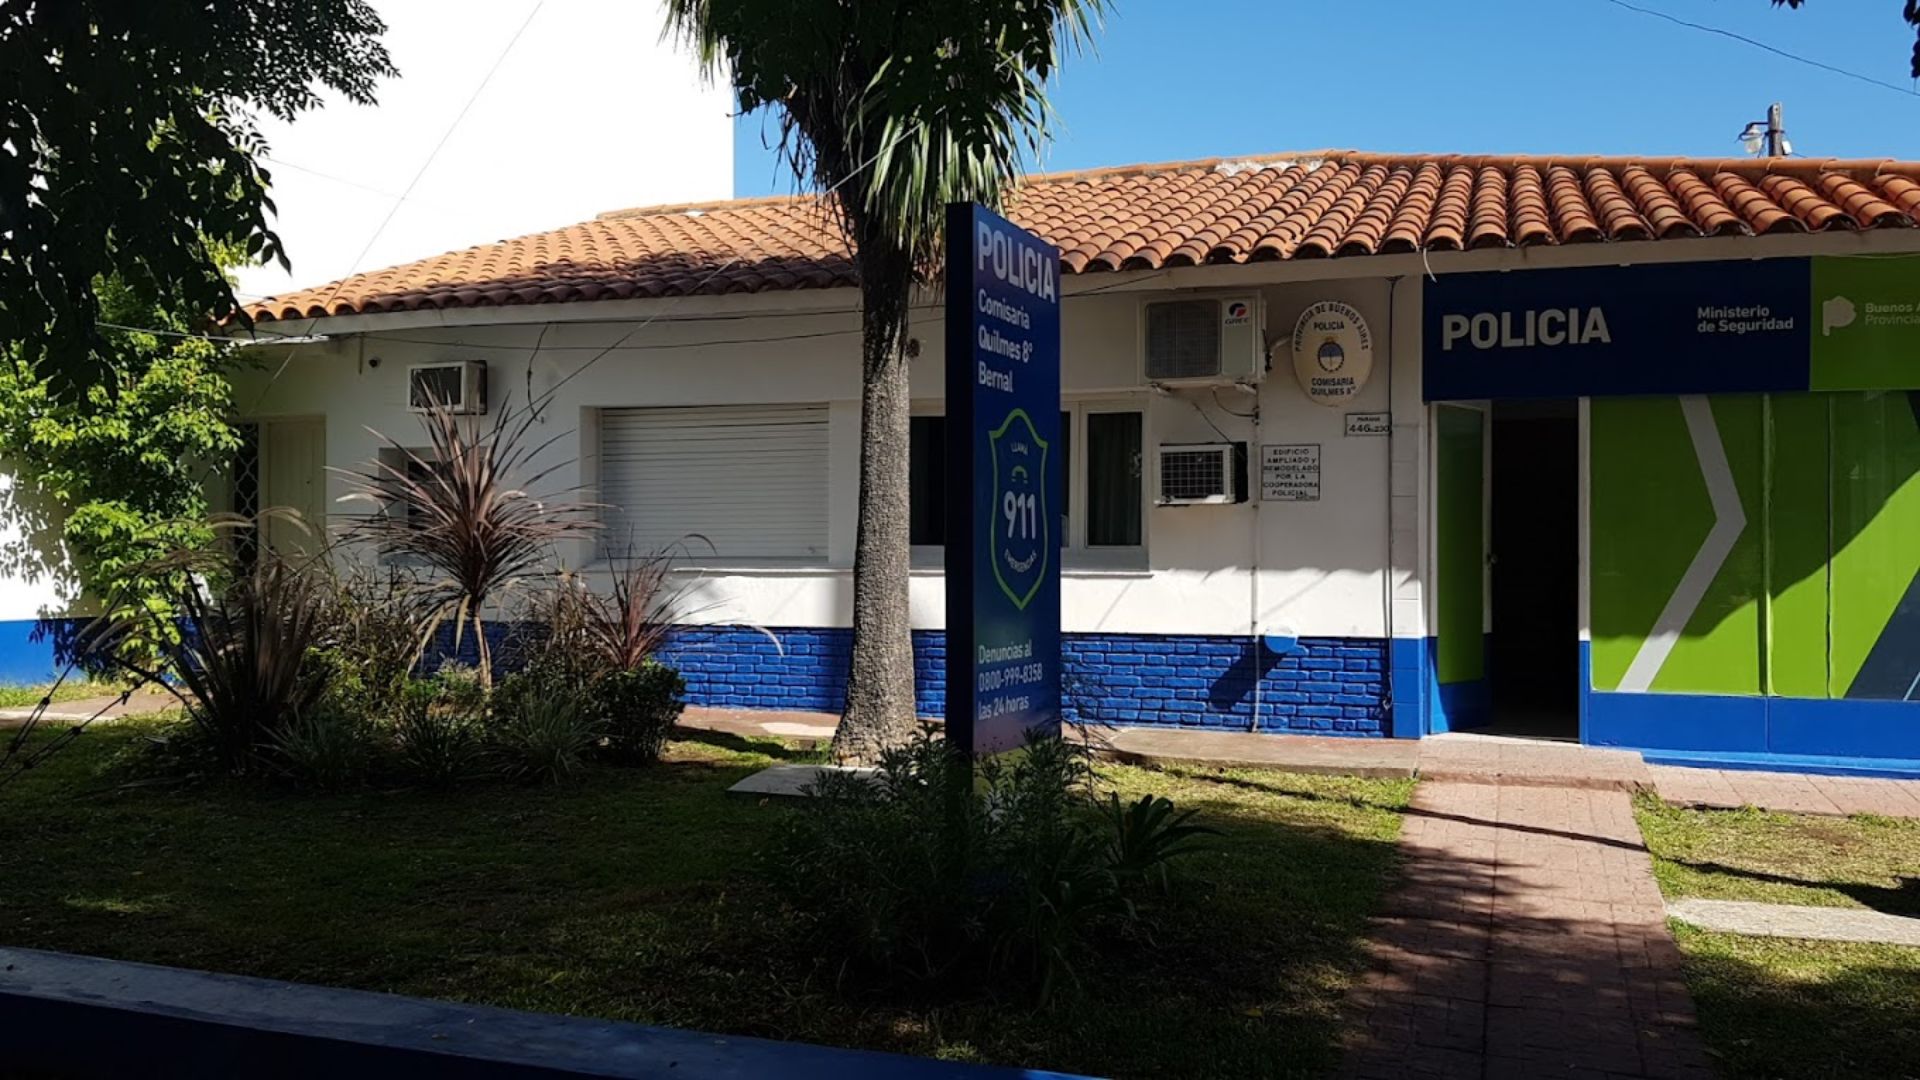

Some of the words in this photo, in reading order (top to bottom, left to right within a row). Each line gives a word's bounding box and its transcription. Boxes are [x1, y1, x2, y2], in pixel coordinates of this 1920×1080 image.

[978, 221, 1055, 303] POLICIA
[978, 289, 1030, 329] Comisaria
[1315, 304, 1326, 314] DE
[1328, 303, 1360, 324] BUENOS
[1697, 304, 1770, 320] Ministerio
[1865, 302, 1913, 313] Buenos
[1442, 306, 1612, 351] POLICIA
[1697, 320, 1716, 333] de
[1718, 317, 1794, 334] Seguridad
[978, 325, 1021, 361] Quilmes
[978, 361, 1013, 392] Bernal
[1311, 387, 1345, 397] QUILMES
[1273, 448, 1310, 456] EDIFICIO
[1004, 491, 1036, 540] 911
[978, 642, 1023, 664] Denuncias
[1024, 639, 1032, 657] al
[978, 663, 1043, 692] 0800-999-8358
[978, 702, 992, 720] las
[993, 698, 1005, 716] 24
[1005, 696, 1030, 713] horas
